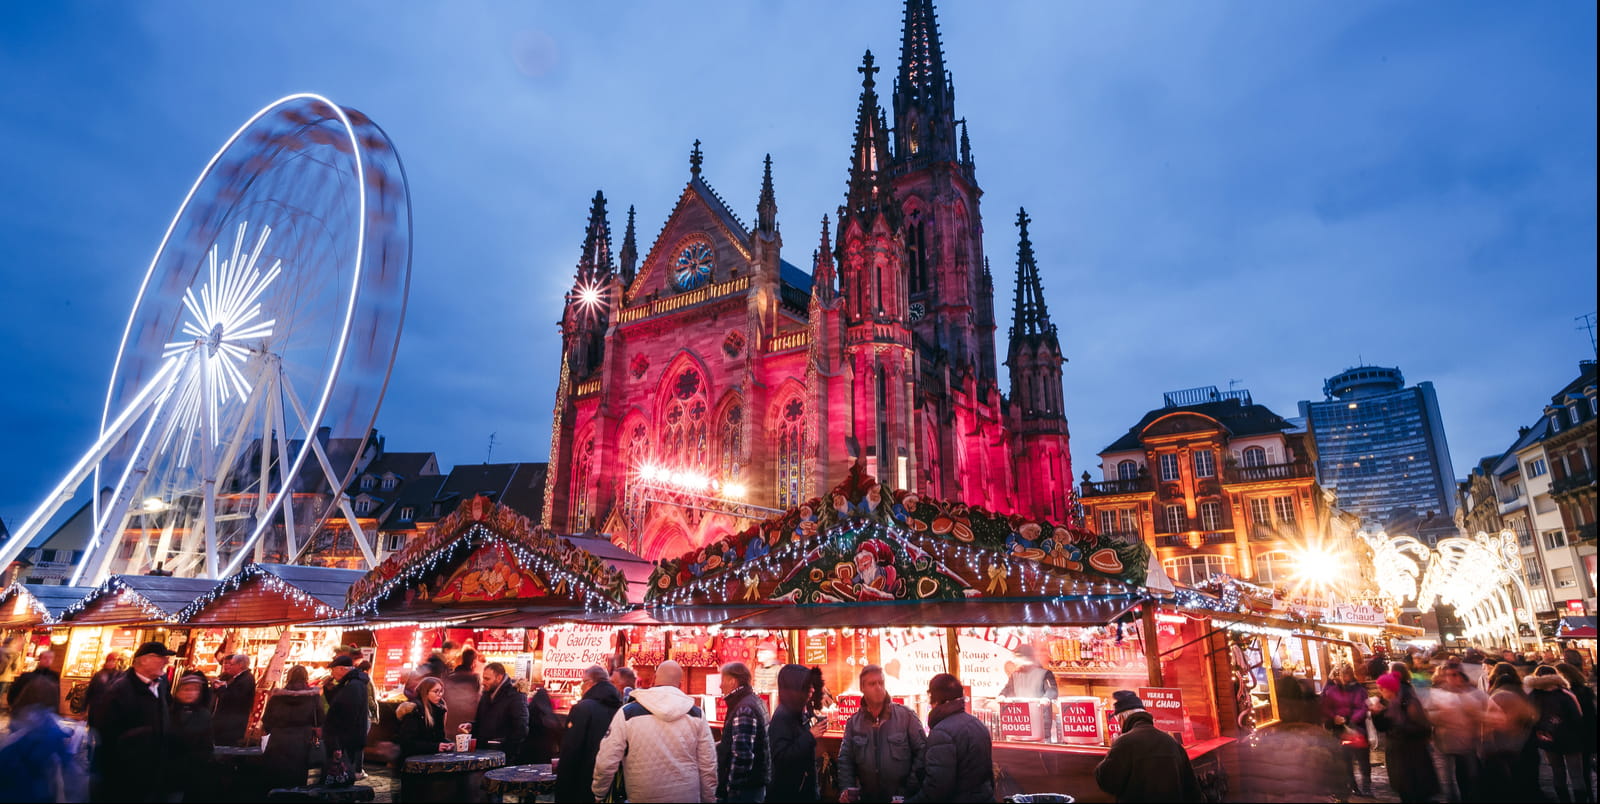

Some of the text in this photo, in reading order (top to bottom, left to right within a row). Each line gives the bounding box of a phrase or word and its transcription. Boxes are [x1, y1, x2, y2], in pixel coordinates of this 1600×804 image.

[1302, 589, 1324, 599] VN
[1294, 598, 1329, 609] CHAUD
[1351, 604, 1369, 614] Vin
[1346, 612, 1375, 621] Chaud
[566, 633, 603, 647] Gaufres
[915, 651, 929, 659] Vin
[962, 651, 990, 662] Rouge
[915, 664, 931, 673] Vin
[964, 664, 991, 673] Blanc
[1155, 700, 1181, 709] CHAUD
[1002, 715, 1030, 723] CHAUD
[1063, 715, 1094, 724] CHAUD
[1002, 724, 1031, 732] ROUGE
[1064, 724, 1096, 733] BLANC
